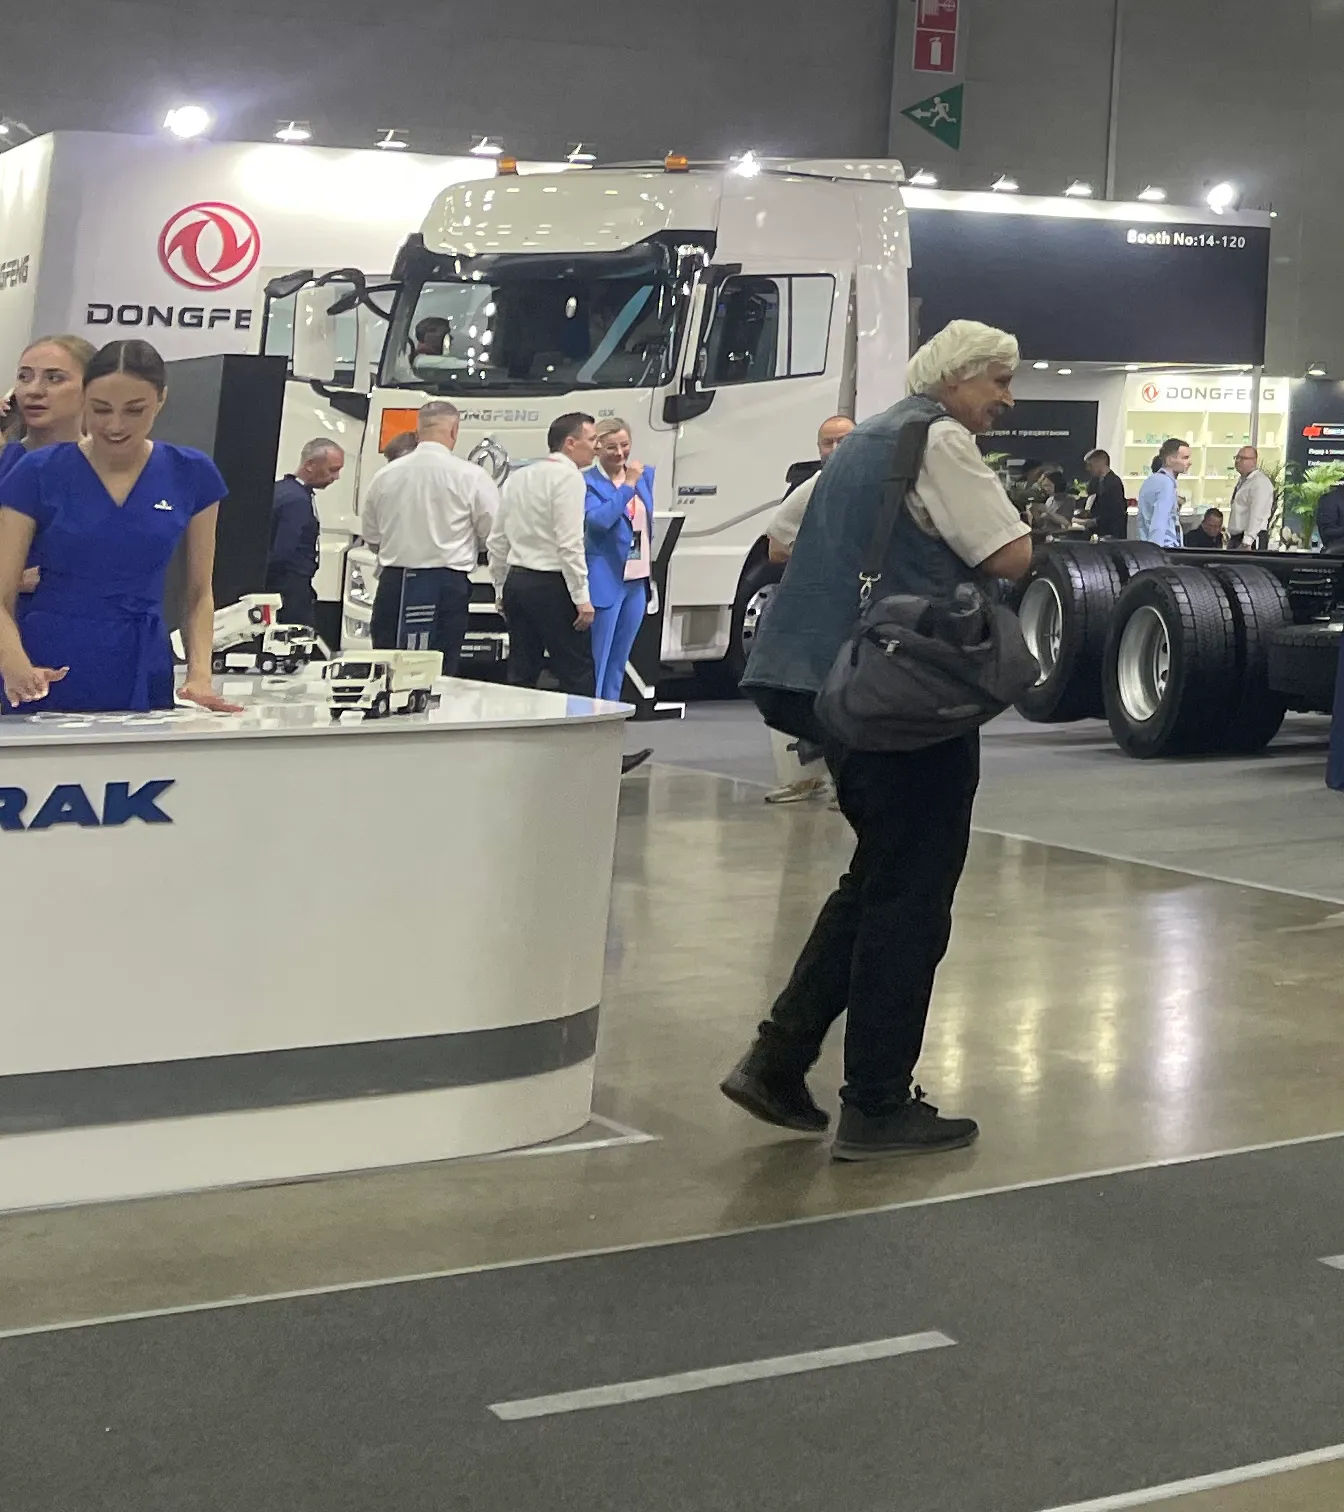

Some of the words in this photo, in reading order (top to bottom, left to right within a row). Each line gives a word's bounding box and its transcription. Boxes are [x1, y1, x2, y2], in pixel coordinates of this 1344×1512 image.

[1126, 228, 1171, 245] Booth
[1172, 231, 1247, 249] No:14-120
[86, 302, 253, 330] DONGFE
[1166, 386, 1276, 401] DONGFEG
[459, 409, 541, 423] ONGFENG
